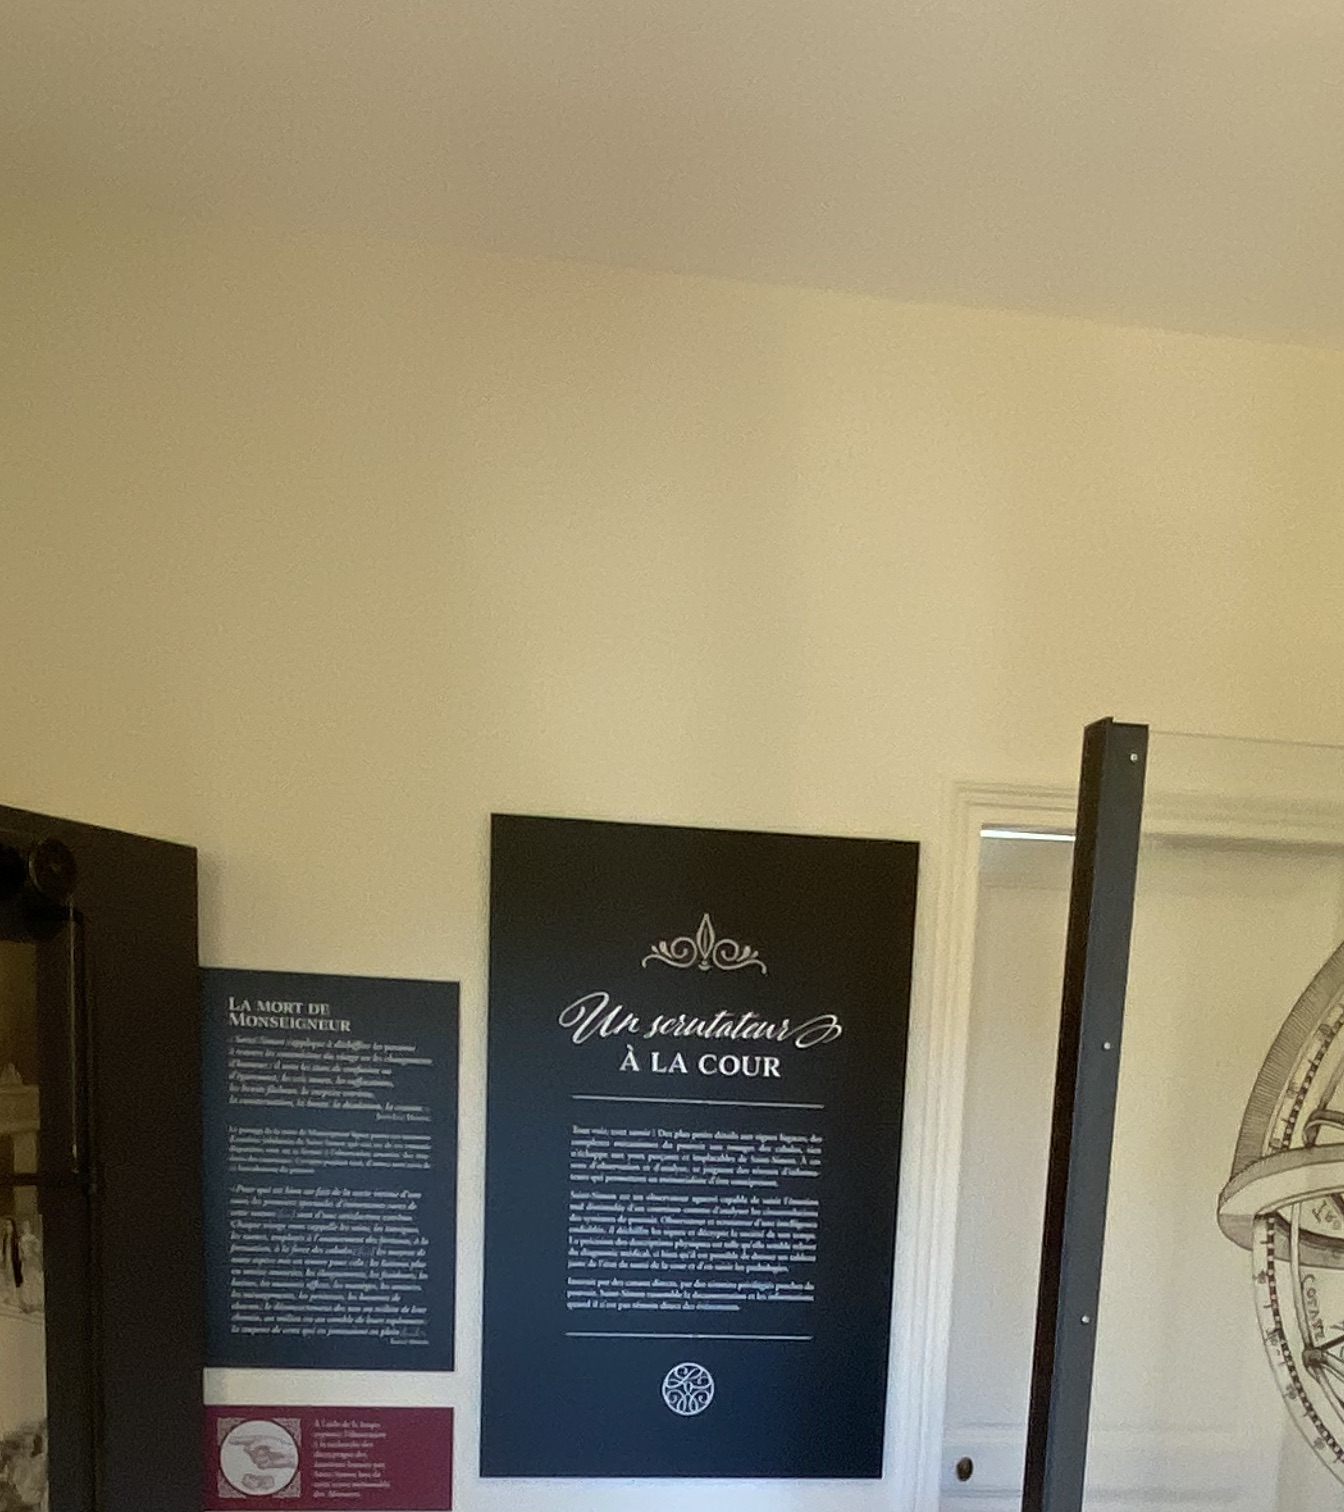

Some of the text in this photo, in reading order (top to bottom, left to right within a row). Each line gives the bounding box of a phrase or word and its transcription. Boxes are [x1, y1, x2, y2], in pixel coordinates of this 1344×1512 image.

[229, 997, 331, 1016] LA MORT DE
[559, 991, 843, 1049] Un scrutateur
[229, 1012, 351, 1033] MONSEIGNEUR
[620, 1044, 781, 1078] À LA COUR
